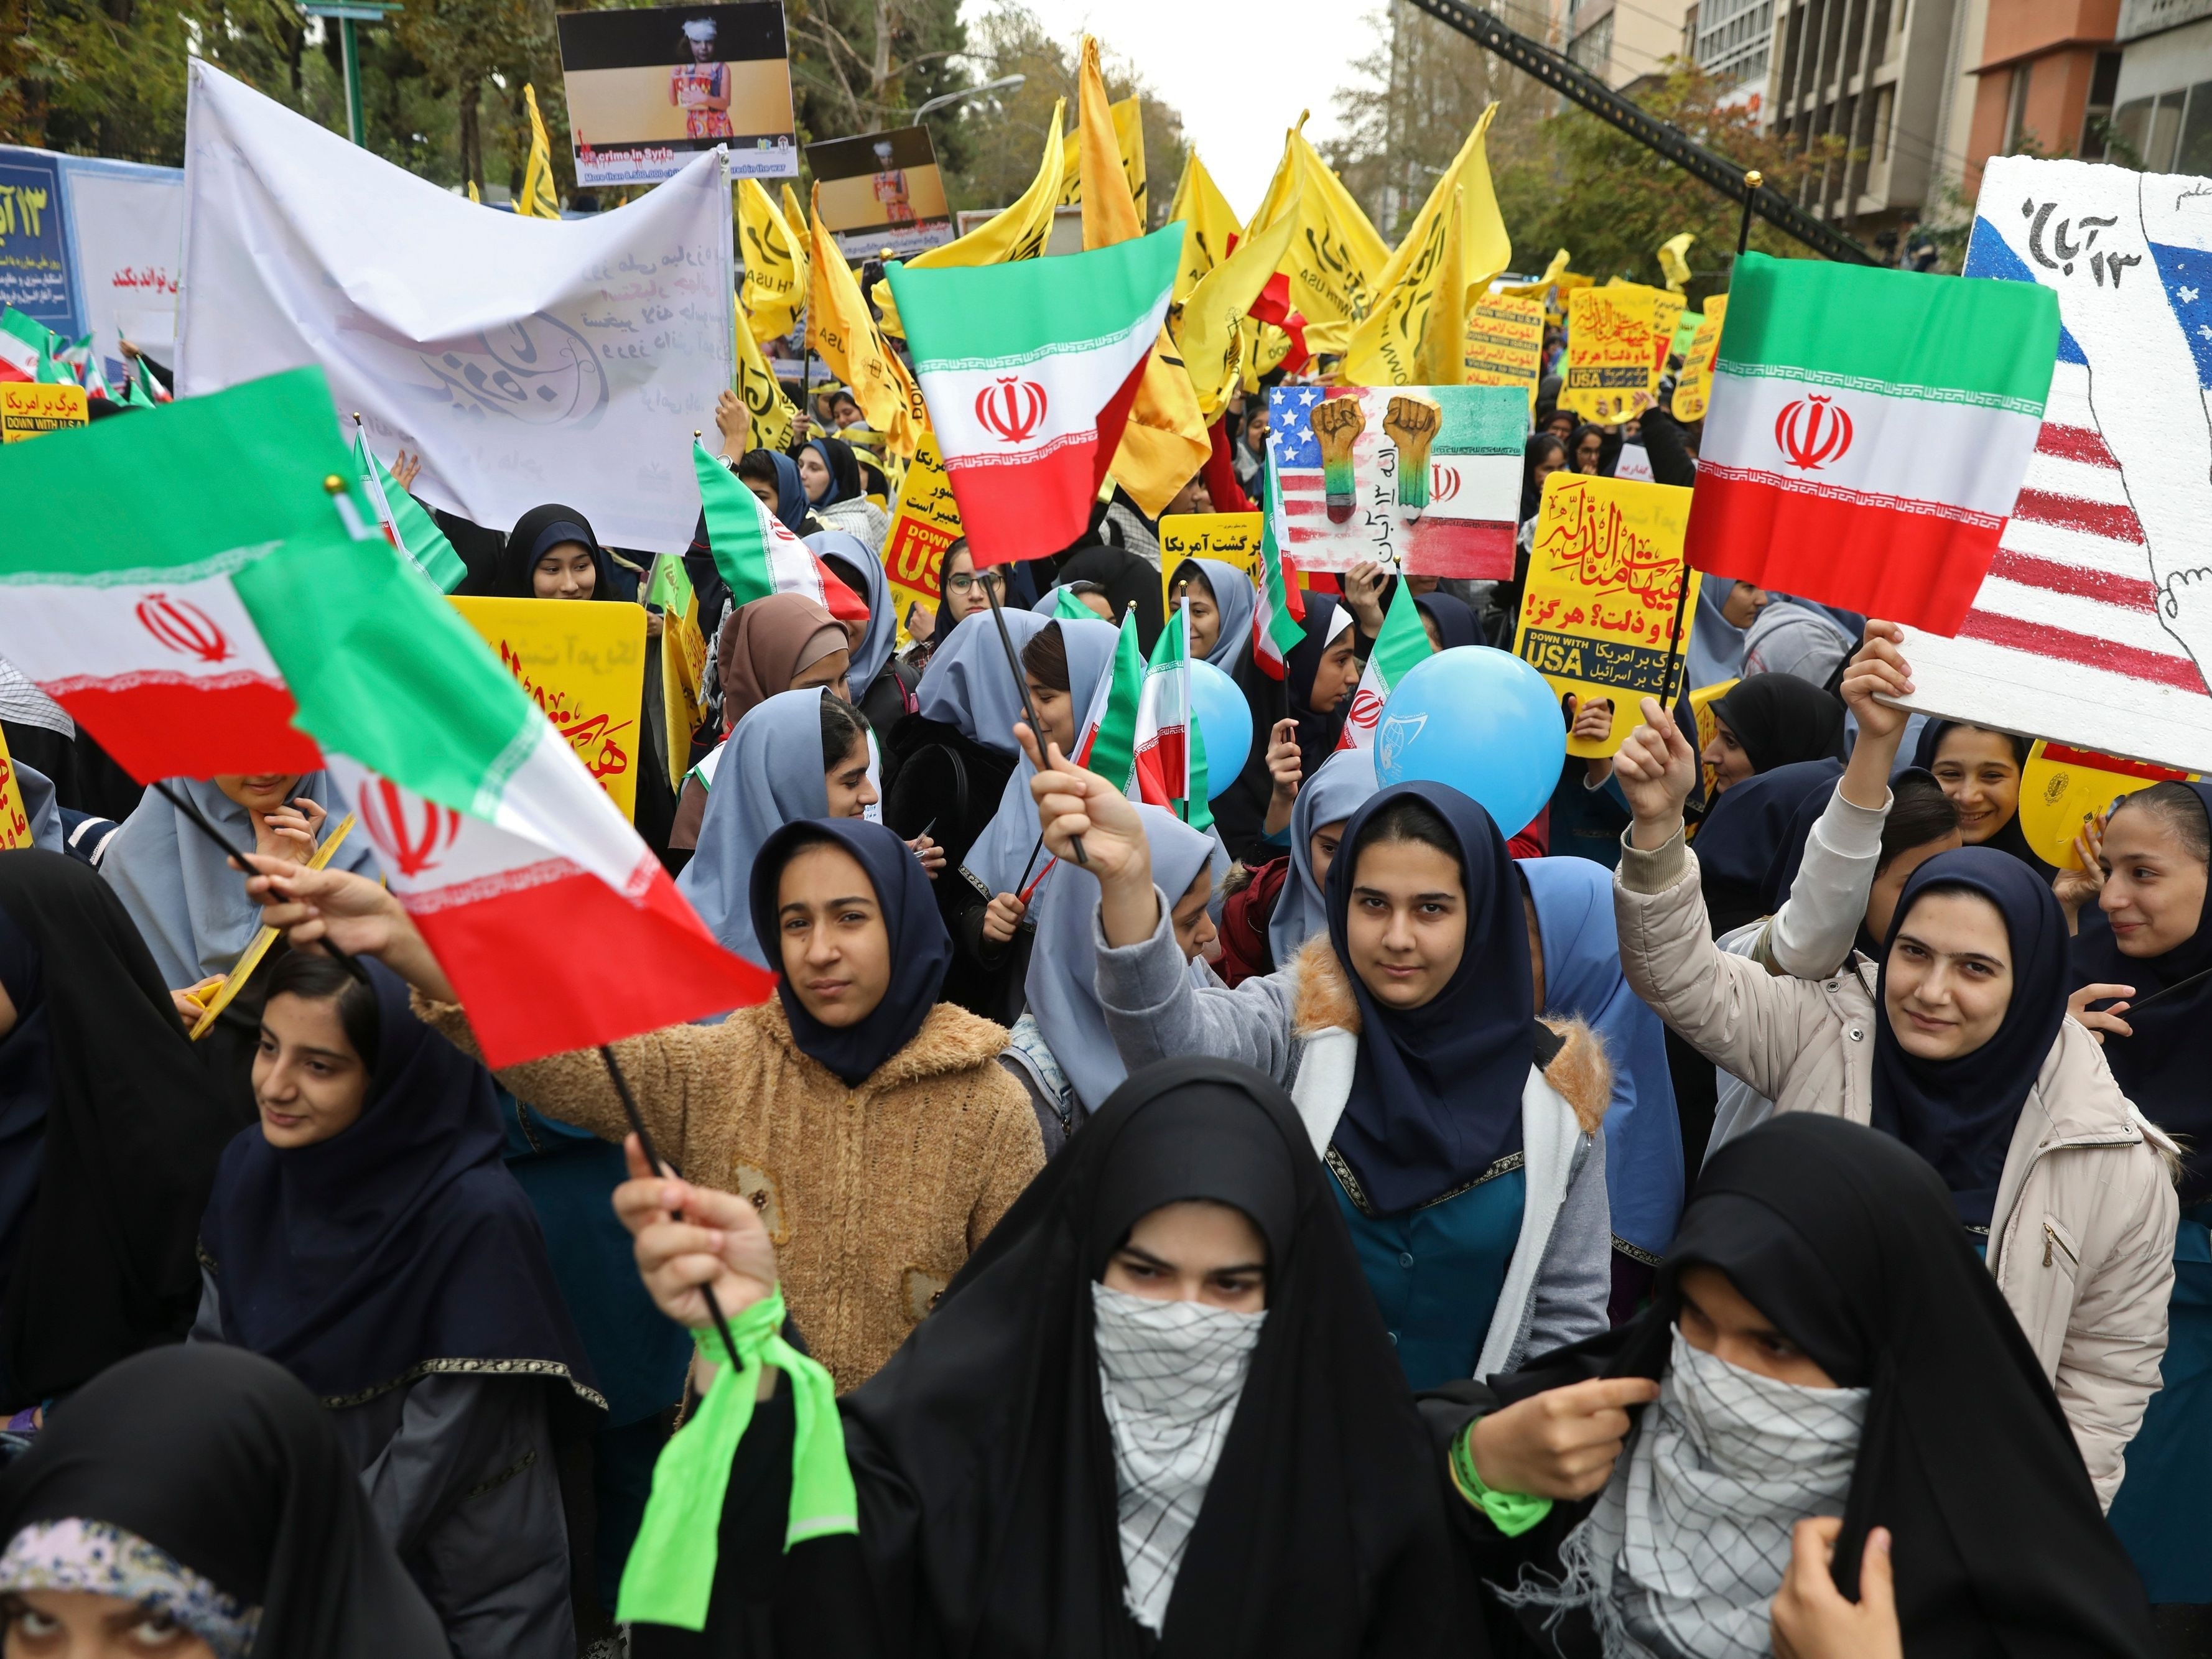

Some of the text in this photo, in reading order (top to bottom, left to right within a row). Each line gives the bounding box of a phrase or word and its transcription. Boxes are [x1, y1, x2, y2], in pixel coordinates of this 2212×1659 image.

[598, 150, 630, 161] crime
[644, 147, 674, 163] Syria
[585, 172, 606, 182] More
[606, 172, 624, 181] than
[747, 164, 756, 174] in
[756, 164, 770, 173] the
[771, 164, 786, 172] war
[16, 185, 47, 238] ۱۳
[2021, 197, 2119, 276] آبان
[1516, 299, 1537, 314] مرگ
[1570, 373, 1602, 388] USA
[6, 391, 78, 417] مرگ بر امریکا
[6, 416, 34, 429] DOWN
[35, 418, 58, 430] WITH
[906, 497, 934, 514] است
[1164, 534, 1211, 557] آمریکا
[1365, 510, 1393, 563] آبان
[1526, 593, 1585, 629] هرگز!
[1590, 603, 1644, 633] ذلت؟
[1530, 631, 1589, 649] DOWN WITH
[1645, 624, 1660, 644] و
[1526, 641, 1582, 676] USA
[1595, 643, 1635, 664] امریکا
[1635, 656, 1649, 670] بر
[1590, 664, 1631, 682] اسرائیل
[1633, 674, 1647, 686] بر
[11, 806, 26, 837] ما
